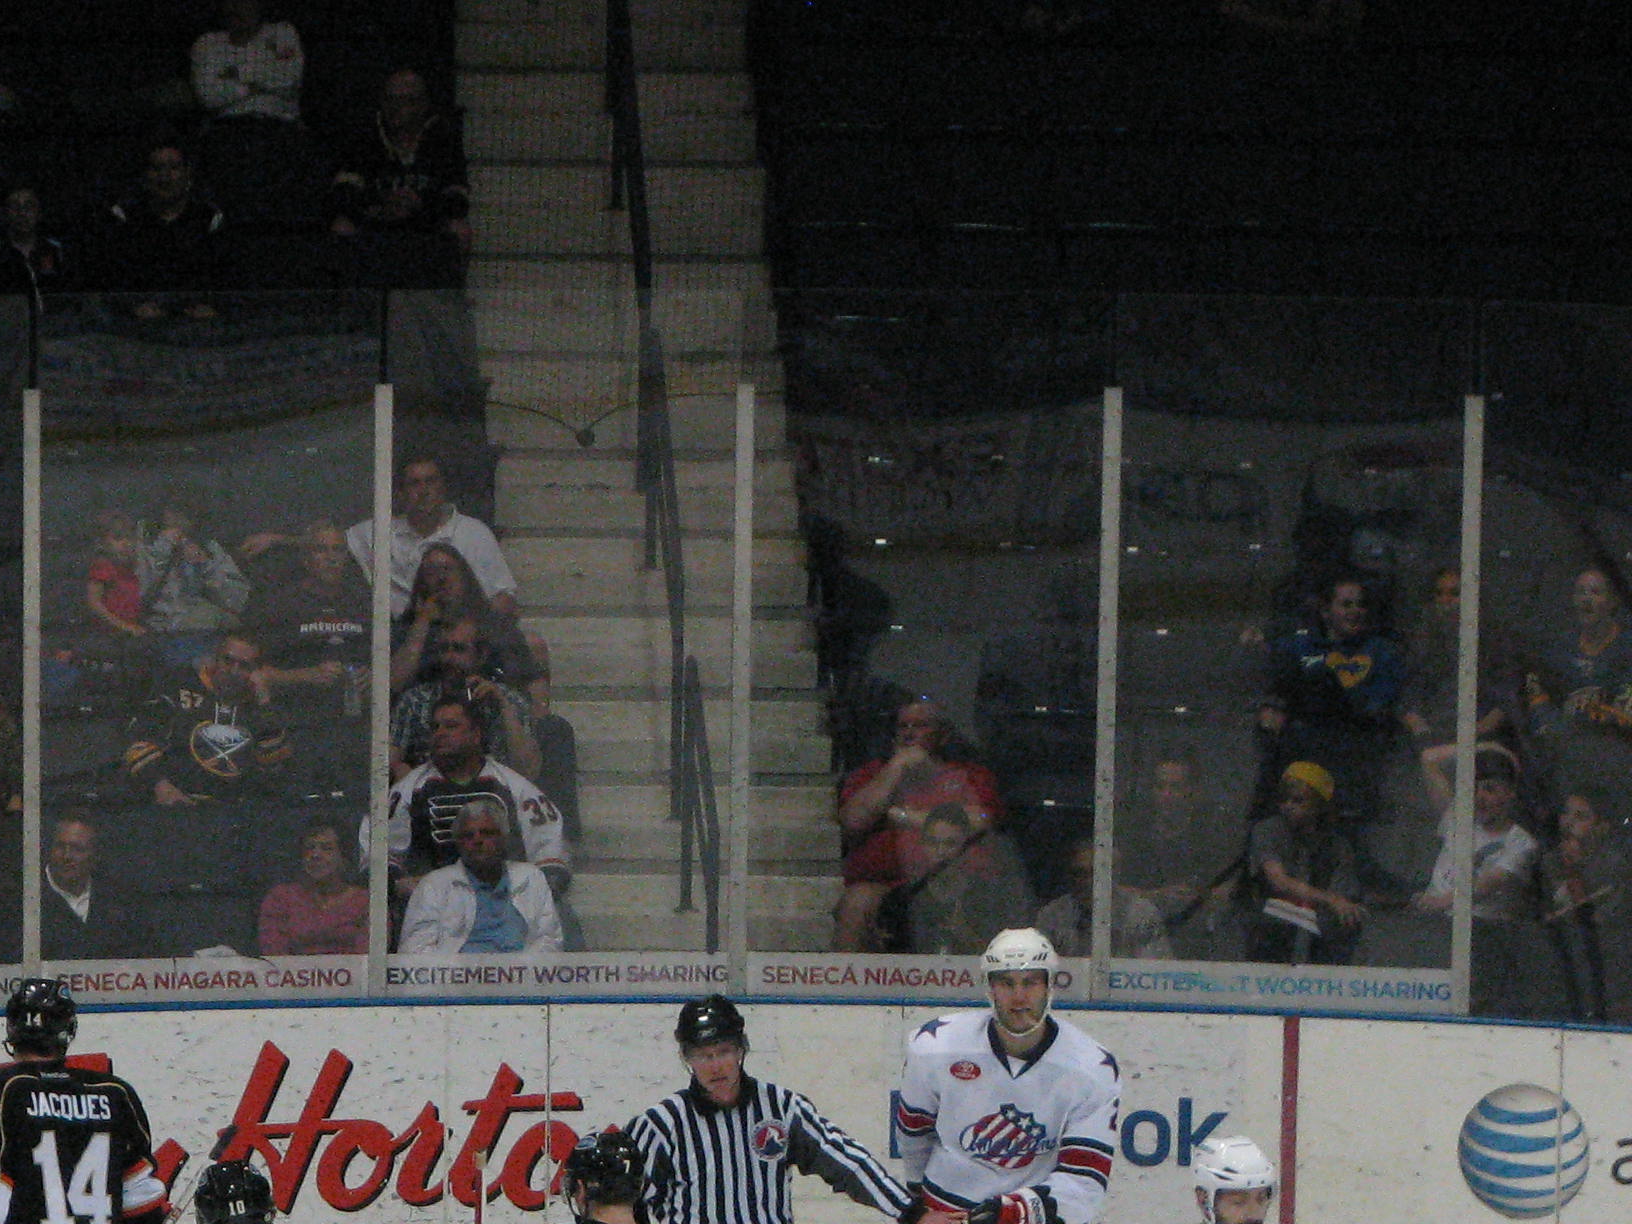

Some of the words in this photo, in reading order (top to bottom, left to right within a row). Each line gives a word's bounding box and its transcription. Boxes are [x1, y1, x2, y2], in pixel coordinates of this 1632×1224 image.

[58, 973, 148, 993] SENECA
[153, 970, 259, 991] NIAGARA
[264, 968, 351, 988] CASINO
[387, 966, 527, 984] EXCITEMENT
[533, 964, 620, 984] WORTH
[627, 963, 729, 983] SHARING
[762, 966, 859, 985] SENECA
[864, 967, 975, 988] NIAGARA
[1109, 972, 1250, 993] EXCITEMT
[1256, 977, 1344, 998] WORTH
[1348, 980, 1452, 1001] SHARING
[26, 1012, 43, 1027] 14
[26, 1091, 112, 1121] JACQUES
[214, 1038, 585, 1214] Horto
[622, 1159, 632, 1174] 7
[229, 1199, 246, 1217] 10
